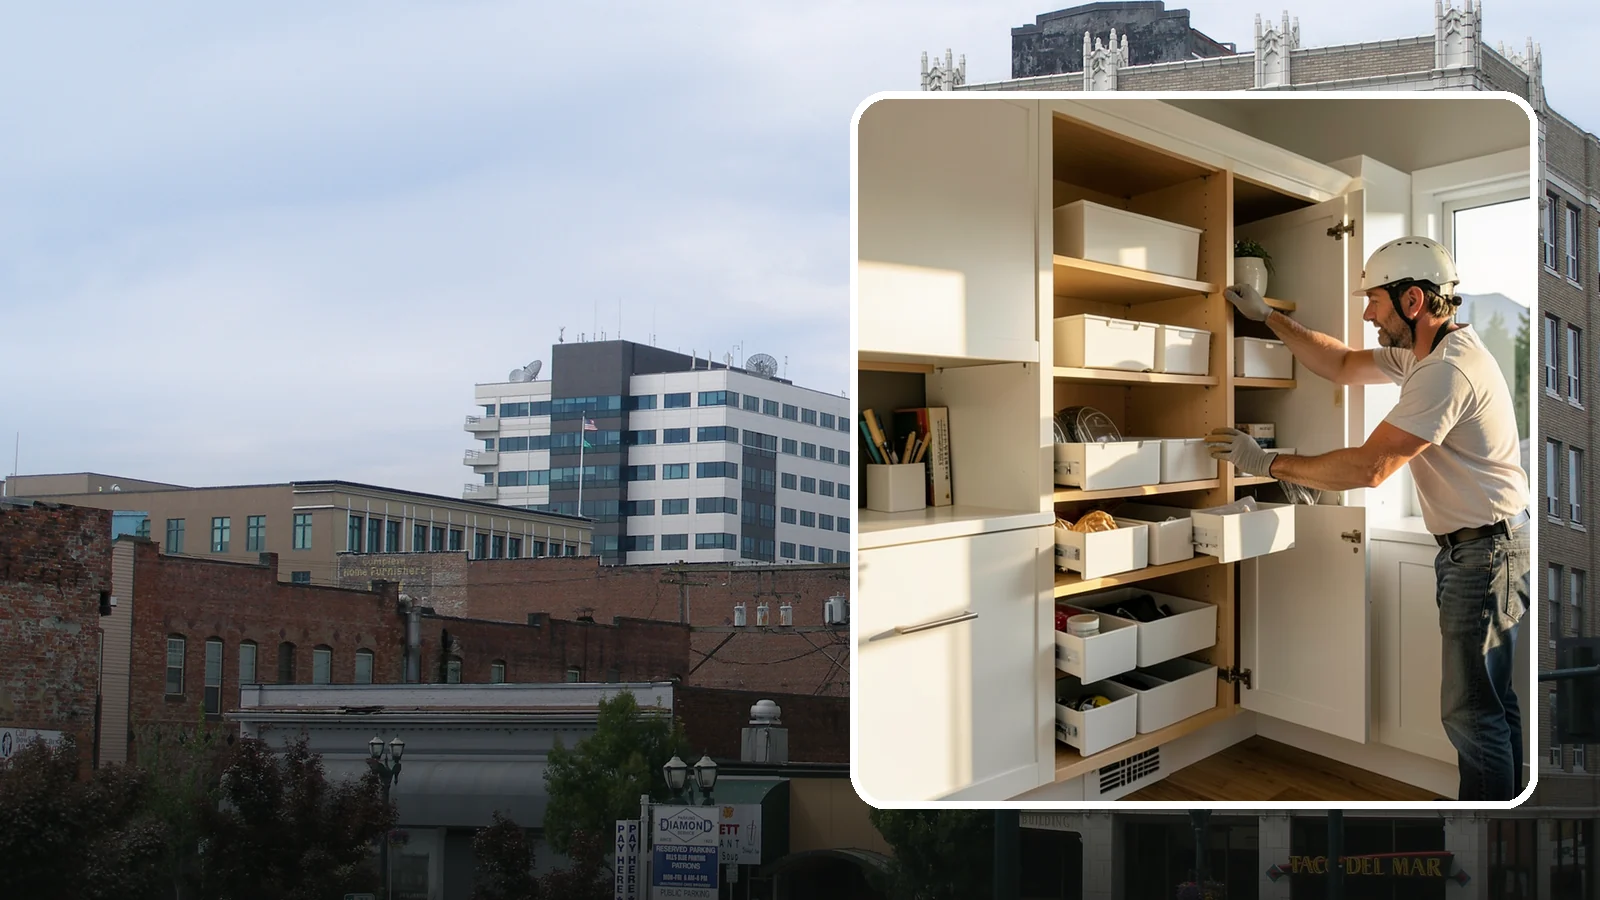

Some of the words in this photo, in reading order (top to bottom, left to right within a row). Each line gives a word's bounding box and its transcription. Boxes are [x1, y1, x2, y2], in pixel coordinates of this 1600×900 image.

[343, 568, 368, 577] Home
[370, 565, 428, 577] Furnishers
[660, 817, 713, 833] DIAMOND
[1022, 815, 1070, 828] BUILDING
[617, 824, 625, 853] PAY
[628, 824, 637, 853] PAY
[656, 845, 688, 853] RESERVED
[689, 846, 716, 854] PARKING
[721, 851, 739, 862] Soup
[671, 862, 701, 870] PATRONS
[1345, 856, 1385, 876] DEL
[1391, 856, 1443, 877] MAR
[616, 856, 625, 894] HERE
[627, 855, 637, 894] HERE
[660, 888, 682, 897] PUBLIC
[683, 889, 710, 898] PARKING
